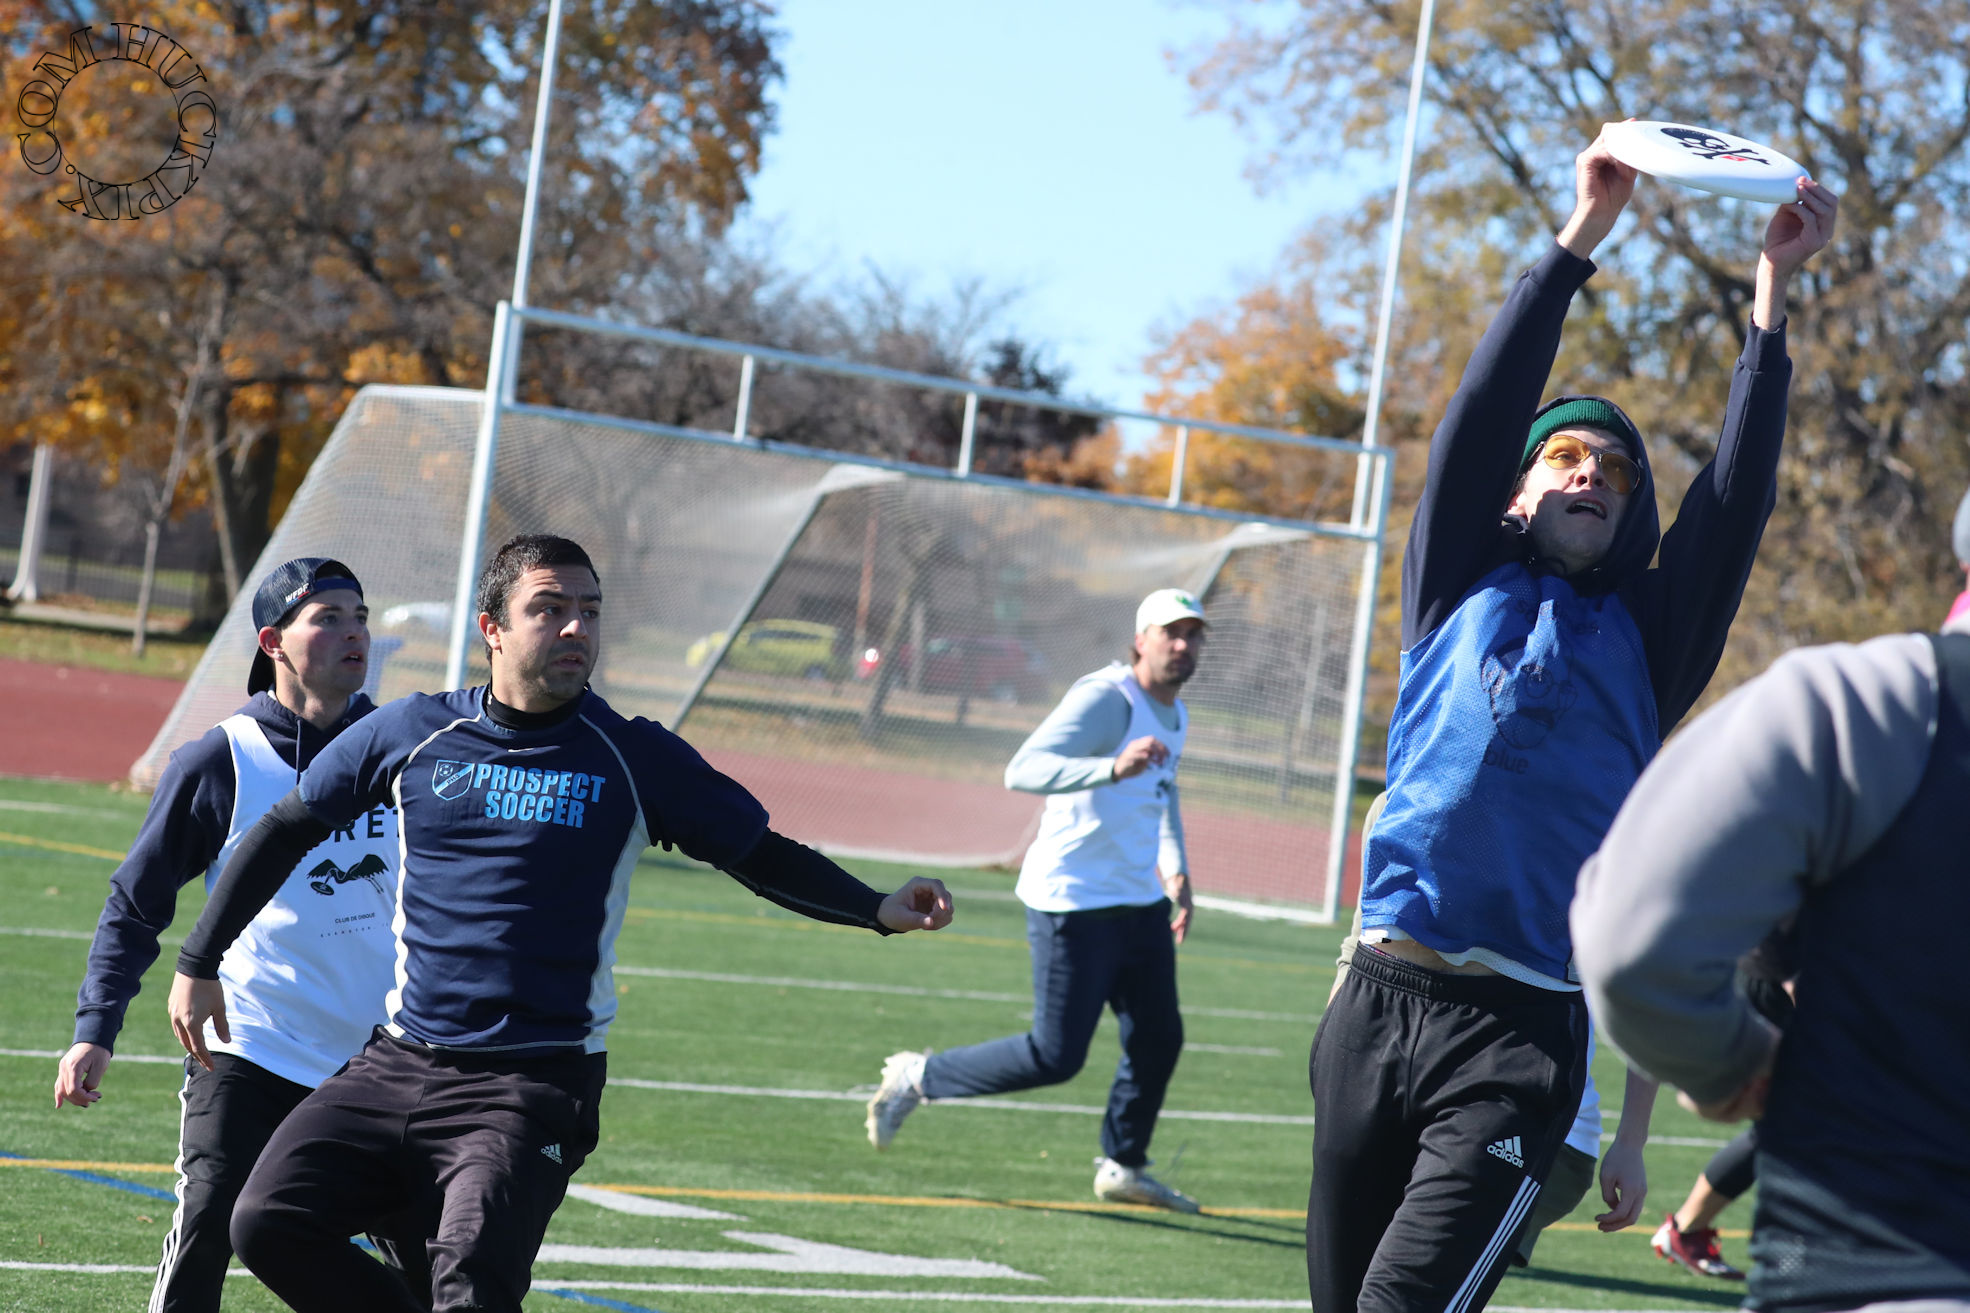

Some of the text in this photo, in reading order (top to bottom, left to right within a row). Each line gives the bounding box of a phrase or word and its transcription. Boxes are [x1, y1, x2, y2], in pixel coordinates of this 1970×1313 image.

[473, 763, 606, 803] PROSPECT
[485, 791, 585, 828] SOCCER
[334, 916, 350, 924] CLUB
[1486, 1144, 1525, 1168] adidas
